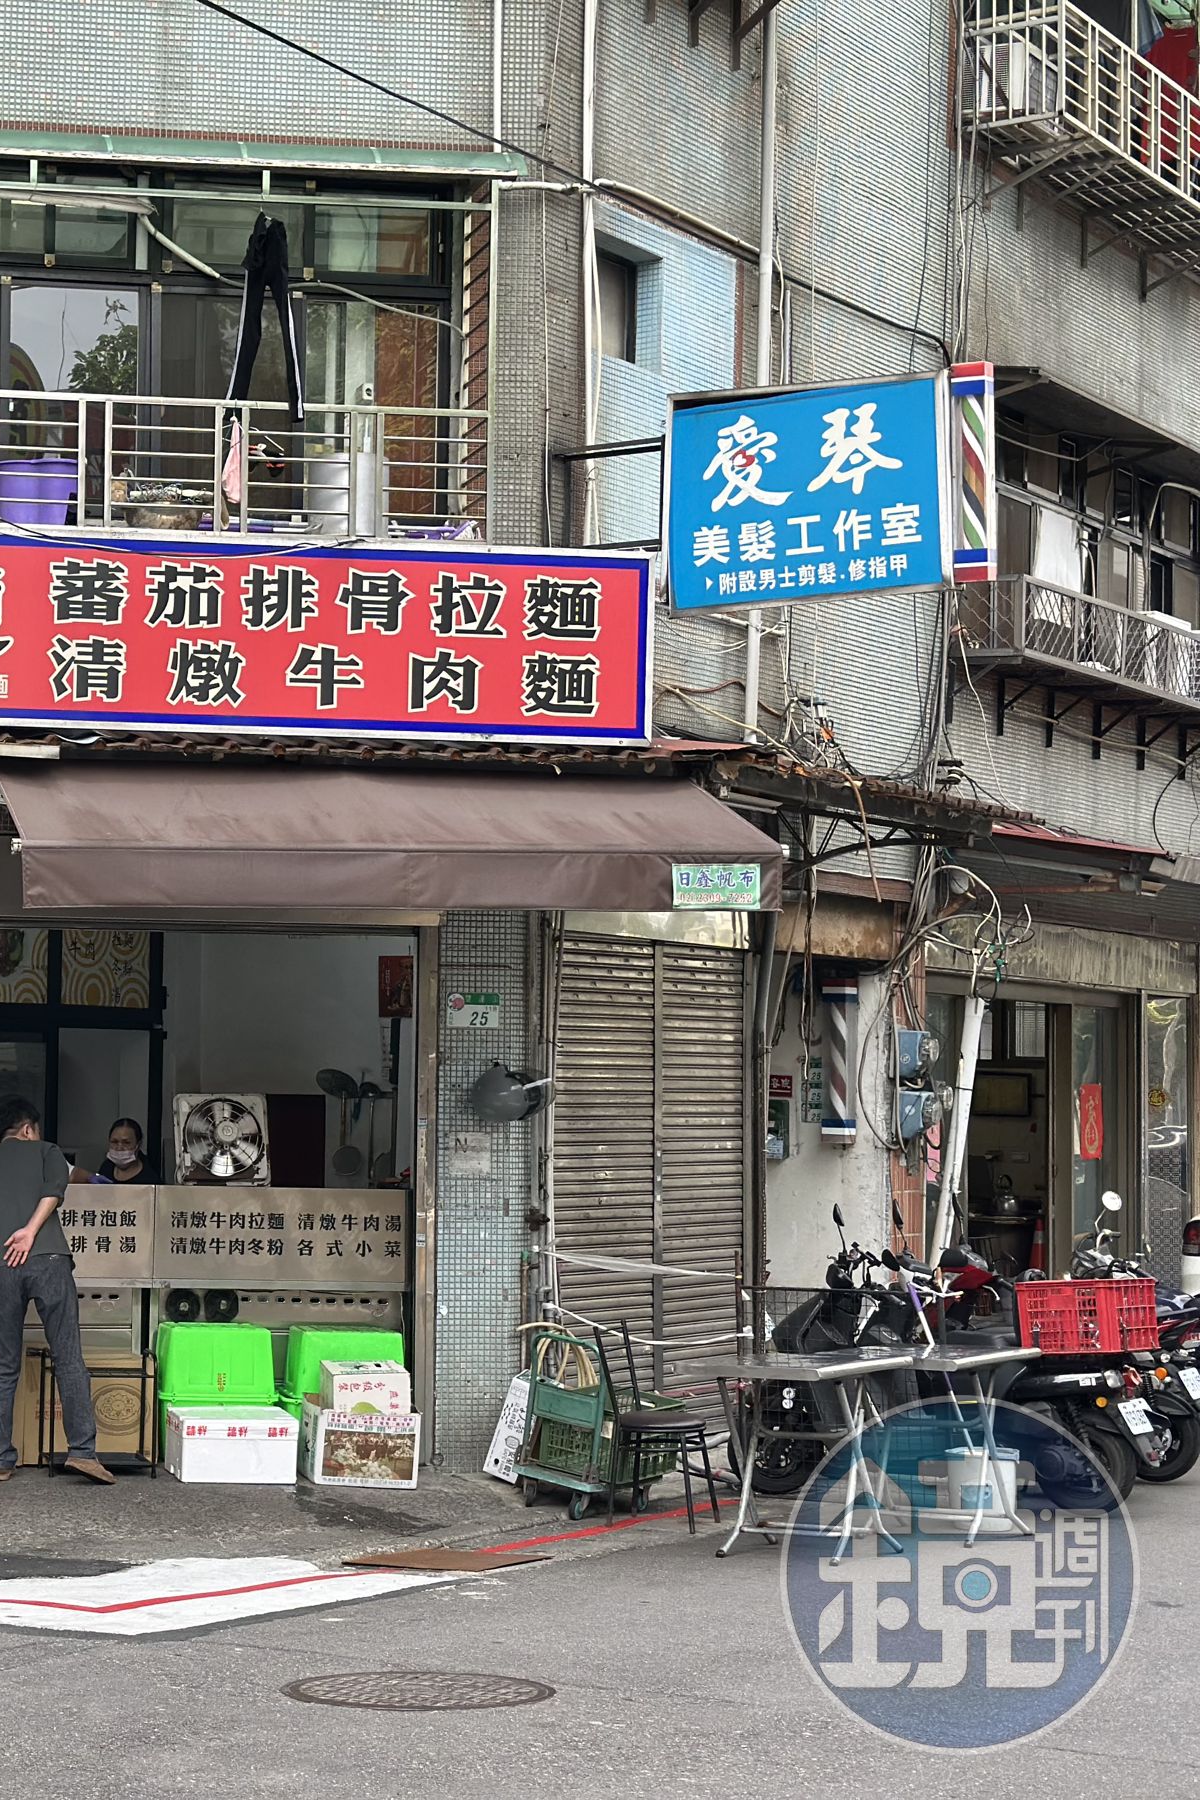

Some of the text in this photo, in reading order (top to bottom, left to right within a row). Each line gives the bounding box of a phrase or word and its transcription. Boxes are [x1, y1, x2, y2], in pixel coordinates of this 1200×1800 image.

[703, 402, 903, 512] 愛琴
[693, 503, 922, 567] 美髮工作室
[49, 556, 603, 643] 蕃茄排骨拉麵
[46, 633, 601, 718] 清燉牛肉麵
[678, 868, 755, 888] 日鑫帆布
[469, 1011, 489, 1026] 25
[810, 1113, 821, 1121] 25
[61, 1210, 137, 1227] 排骨泡飯
[171, 1211, 402, 1232] 清燉牛肉拉麵 清燉牛肉湯
[70, 1236, 137, 1253] 排骨湯
[170, 1237, 402, 1258] 清燉牛肉冬粉 各式小菜
